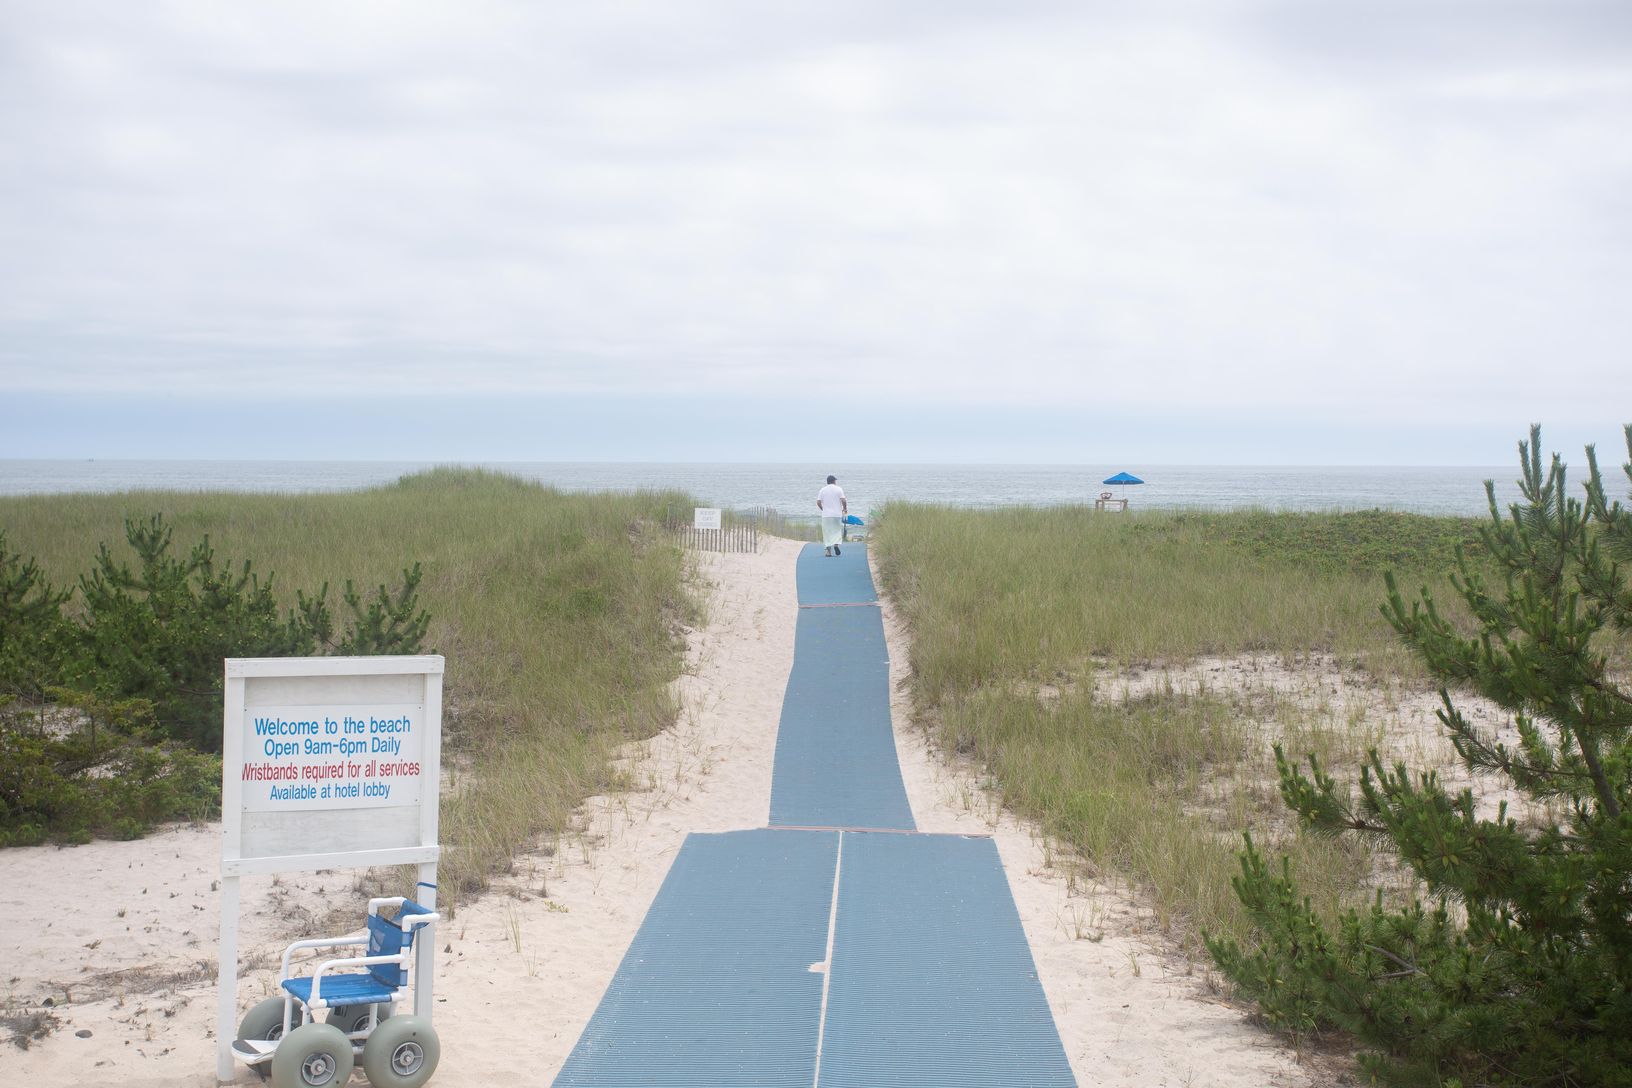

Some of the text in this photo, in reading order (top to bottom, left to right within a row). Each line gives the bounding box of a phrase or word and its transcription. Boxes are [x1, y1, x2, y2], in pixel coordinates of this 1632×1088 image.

[254, 716, 410, 736] Welcome to the beach
[264, 737, 401, 759] Open 9am-6pm Daily
[242, 759, 420, 783] Wristbands required for all services
[270, 782, 390, 800] Available at hotel lobby
